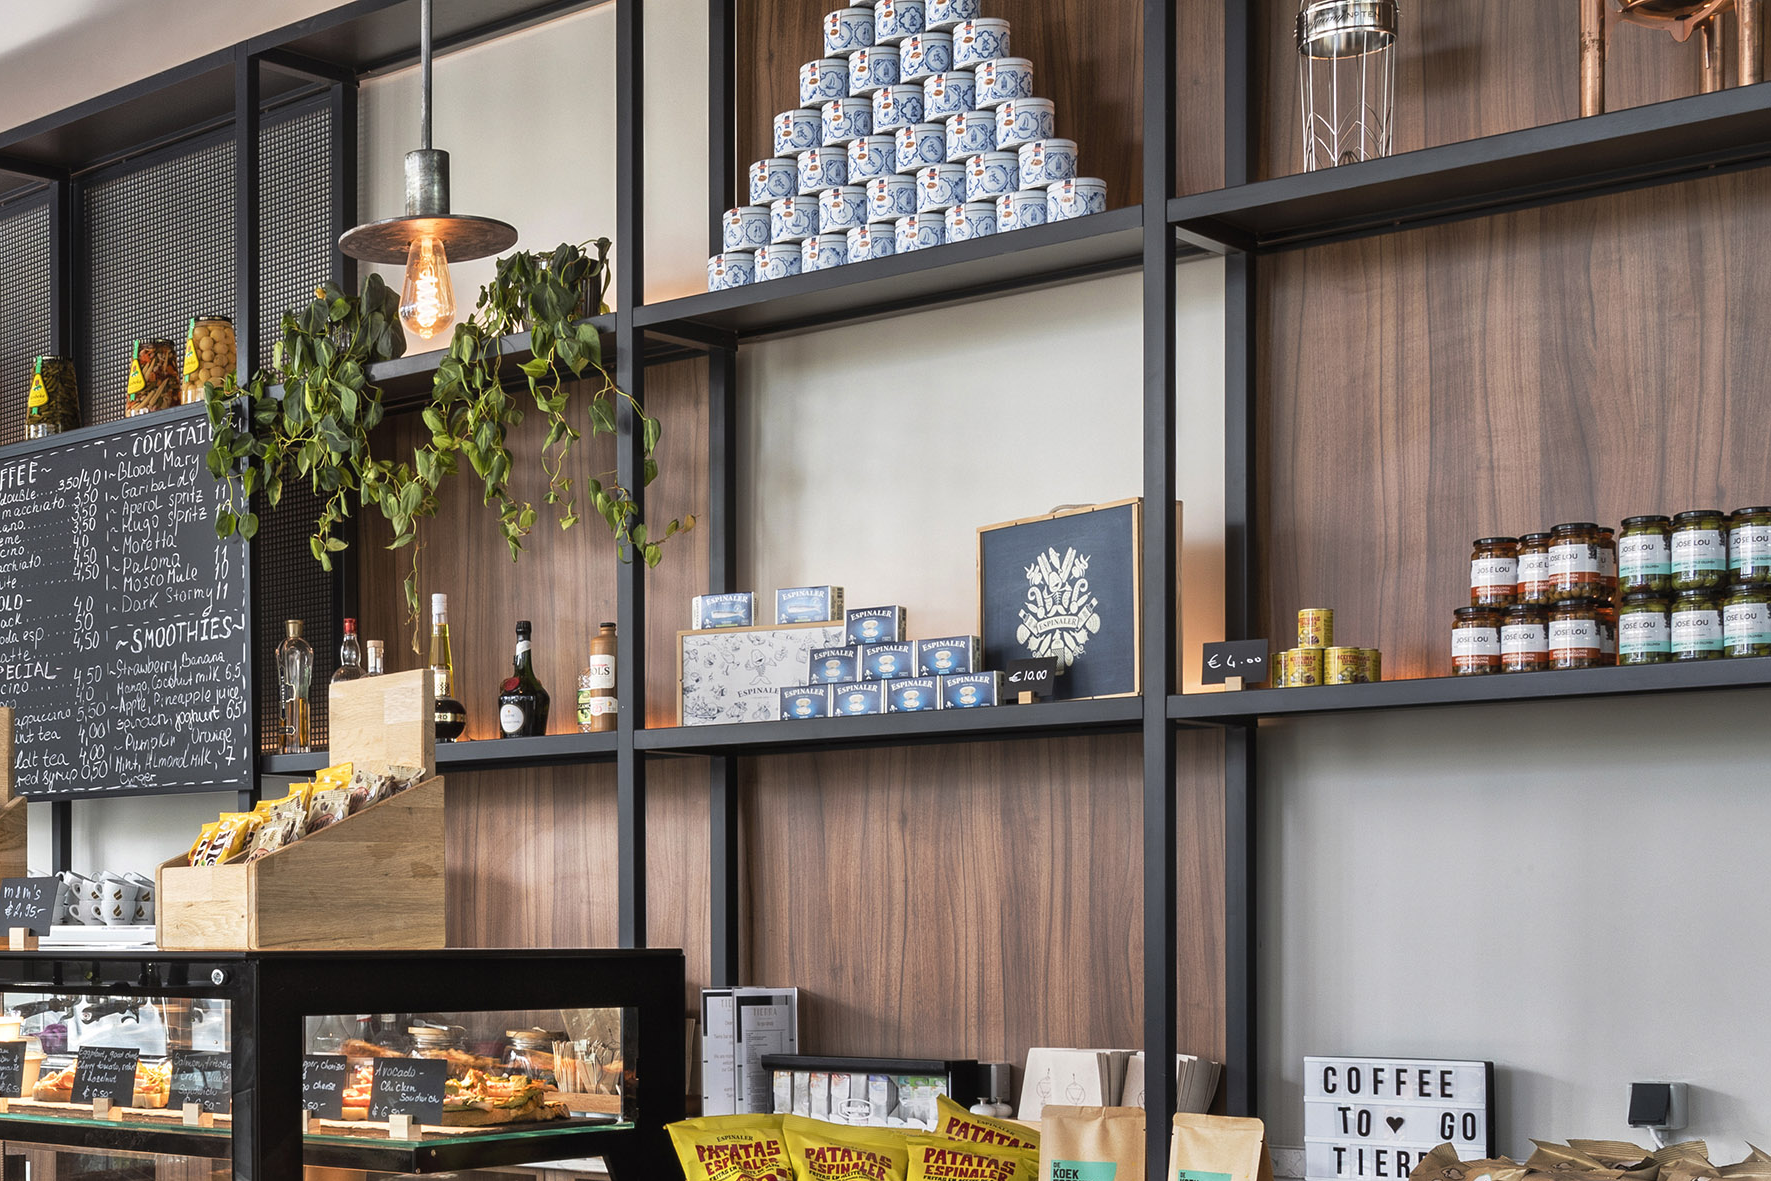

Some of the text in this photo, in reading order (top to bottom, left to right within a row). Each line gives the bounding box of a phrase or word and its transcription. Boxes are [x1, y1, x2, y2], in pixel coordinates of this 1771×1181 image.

[163, 450, 199, 480] Mary
[2, 495, 65, 520] macchiato
[72, 488, 99, 507] 3,50
[72, 503, 97, 523] 3,50
[168, 486, 203, 519] spritz
[72, 517, 96, 536] 3,50
[122, 505, 207, 541] Hugo spritz
[73, 534, 90, 550] 4,0
[122, 530, 177, 554] Moretta
[73, 547, 97, 568] 4,50
[73, 565, 99, 582] 4,50
[167, 563, 198, 583] Mule
[215, 560, 228, 580] 10
[165, 586, 213, 617] Stormy
[706, 594, 748, 605] ESPINALER
[781, 589, 825, 601] ESPINALER
[73, 596, 94, 616] 4,0
[849, 609, 893, 622] ESPINALER
[23, 627, 44, 650] esp
[73, 613, 94, 633] 5,0
[130, 616, 233, 653] SMOOTHIES
[1039, 617, 1077, 631] ESPINALER
[73, 631, 100, 652] 4,50
[866, 644, 910, 656] ESPINALER
[922, 640, 966, 652] ESPINALER
[813, 649, 854, 661] ESPINALER
[1207, 653, 1262, 669] € 4.00
[73, 665, 102, 690] 4,50
[891, 679, 933, 692] ESPINALER
[946, 675, 990, 688] ESPINALER
[1008, 669, 1048, 683] € 10.00
[153, 686, 211, 707] Pineapple
[784, 687, 825, 699] ESPINALER
[837, 684, 878, 696] ESPINALER
[76, 701, 106, 723] 5,50
[37, 722, 105, 746] tea 4,00
[42, 744, 105, 766] tea 4,00
[225, 745, 236, 766] 7
[42, 760, 108, 791] syrup 0,50
[1323, 1066, 1454, 1099] COFFEE
[1338, 1106, 1477, 1141] TO GO
[716, 1134, 754, 1143] ESPINALER
[695, 1140, 781, 1163] PATATAS
[804, 1146, 892, 1170] PATATAS
[923, 1147, 1017, 1177] PATATAS
[809, 1162, 887, 1181] ESPINALER
[1052, 1168, 1079, 1180] KOEK
[1053, 1161, 1062, 1169] DE
